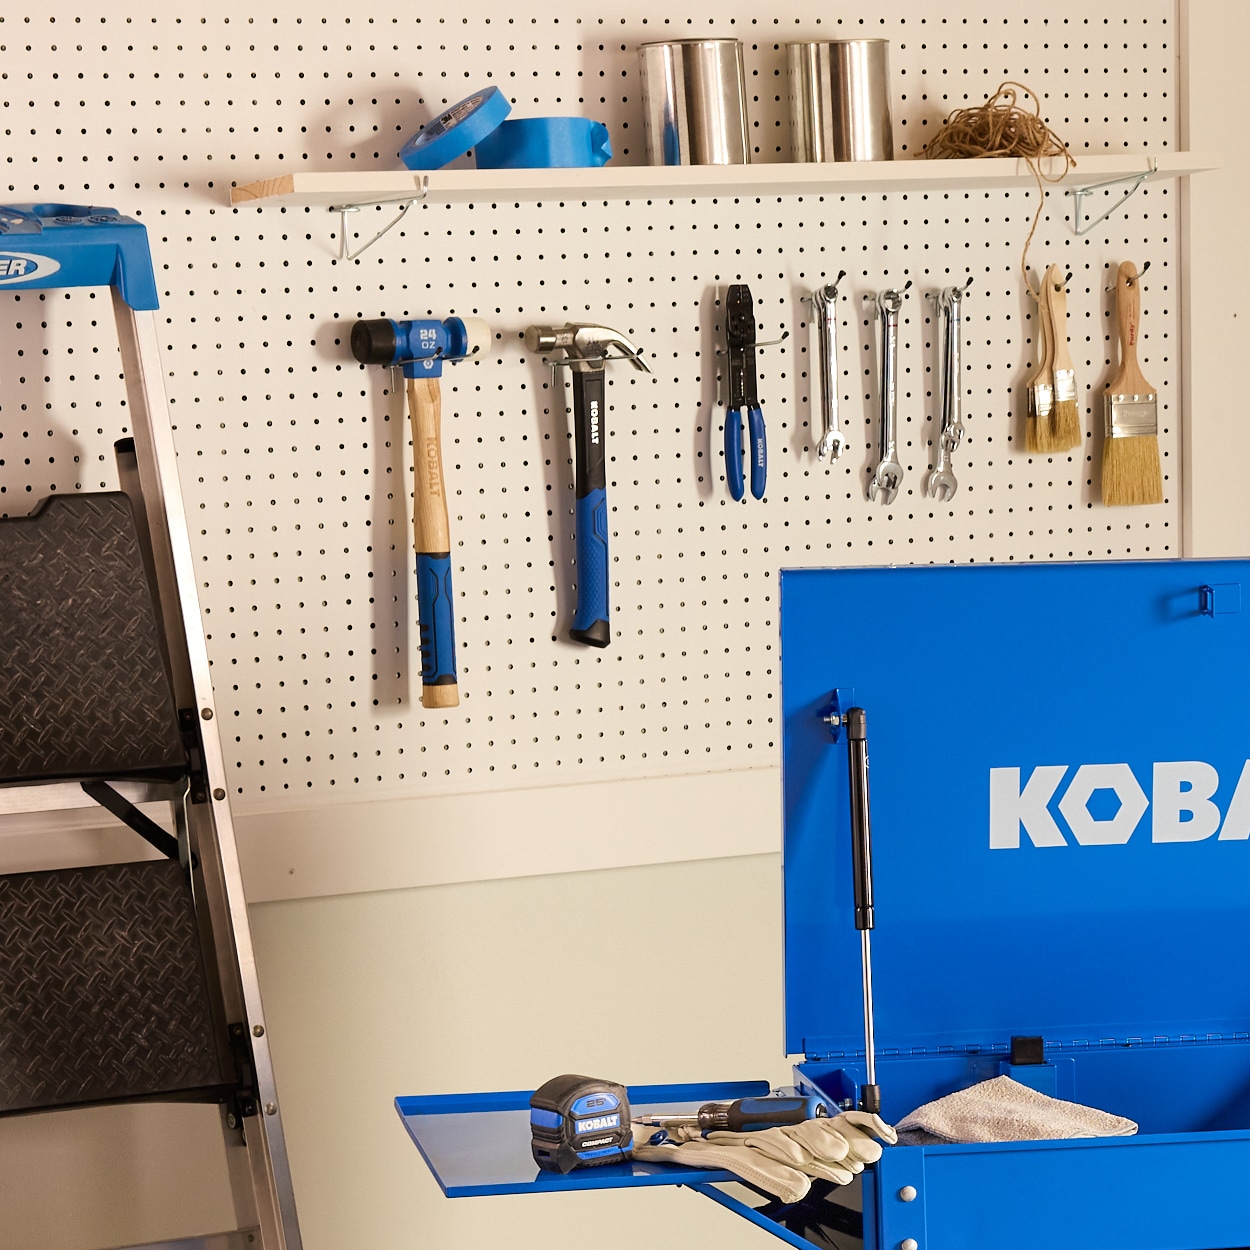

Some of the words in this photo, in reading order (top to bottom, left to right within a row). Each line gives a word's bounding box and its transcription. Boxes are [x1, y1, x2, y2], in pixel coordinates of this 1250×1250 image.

[441, 113, 453, 124] 3M
[420, 329, 437, 340] 24
[421, 341, 436, 349] OZ
[590, 400, 599, 444] KOBALT
[427, 437, 440, 497] KOBALT
[578, 1115, 618, 1132] KOBALT
[581, 1136, 613, 1148] COMPACT
